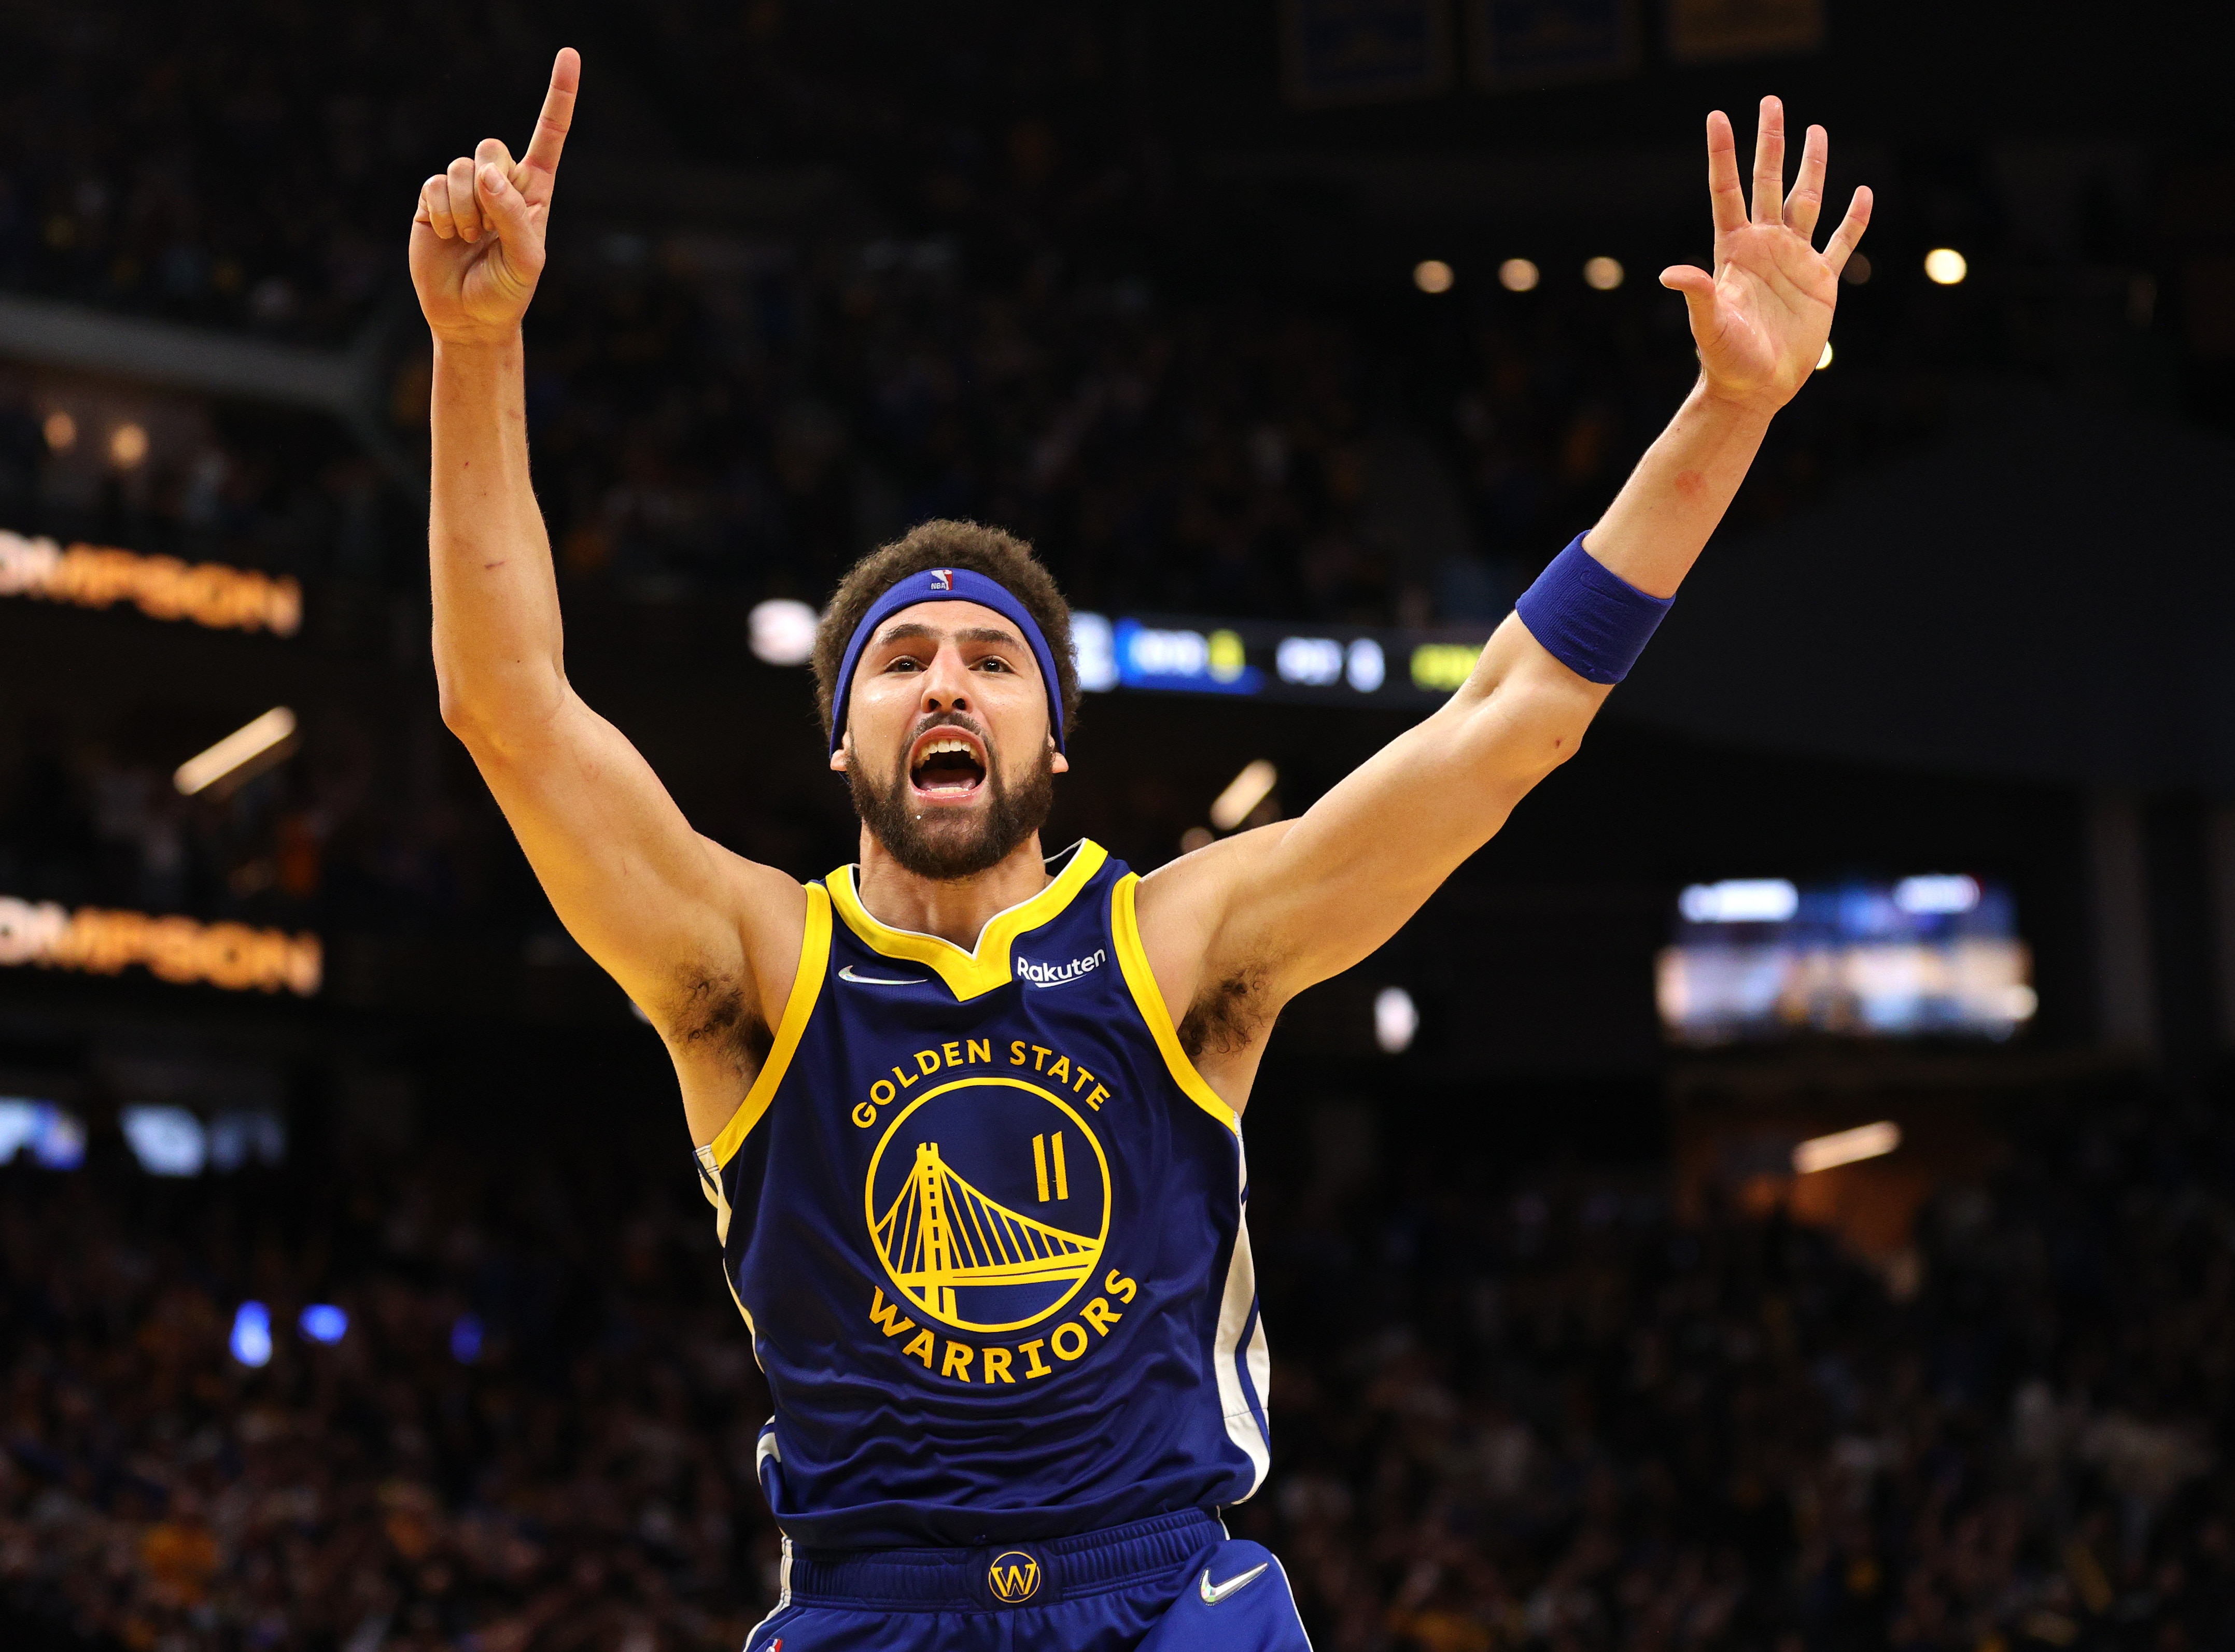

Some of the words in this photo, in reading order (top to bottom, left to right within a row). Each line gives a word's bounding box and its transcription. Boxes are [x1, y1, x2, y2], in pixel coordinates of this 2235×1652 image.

[1017, 949, 1106, 982] Rakuten
[852, 1038, 991, 1128] GOLDEN
[1010, 1040, 1111, 1111] STATE
[1032, 1131, 1069, 1202] 11
[869, 1269, 1137, 1384] WARRIORS
[990, 1563, 1037, 1597] W
